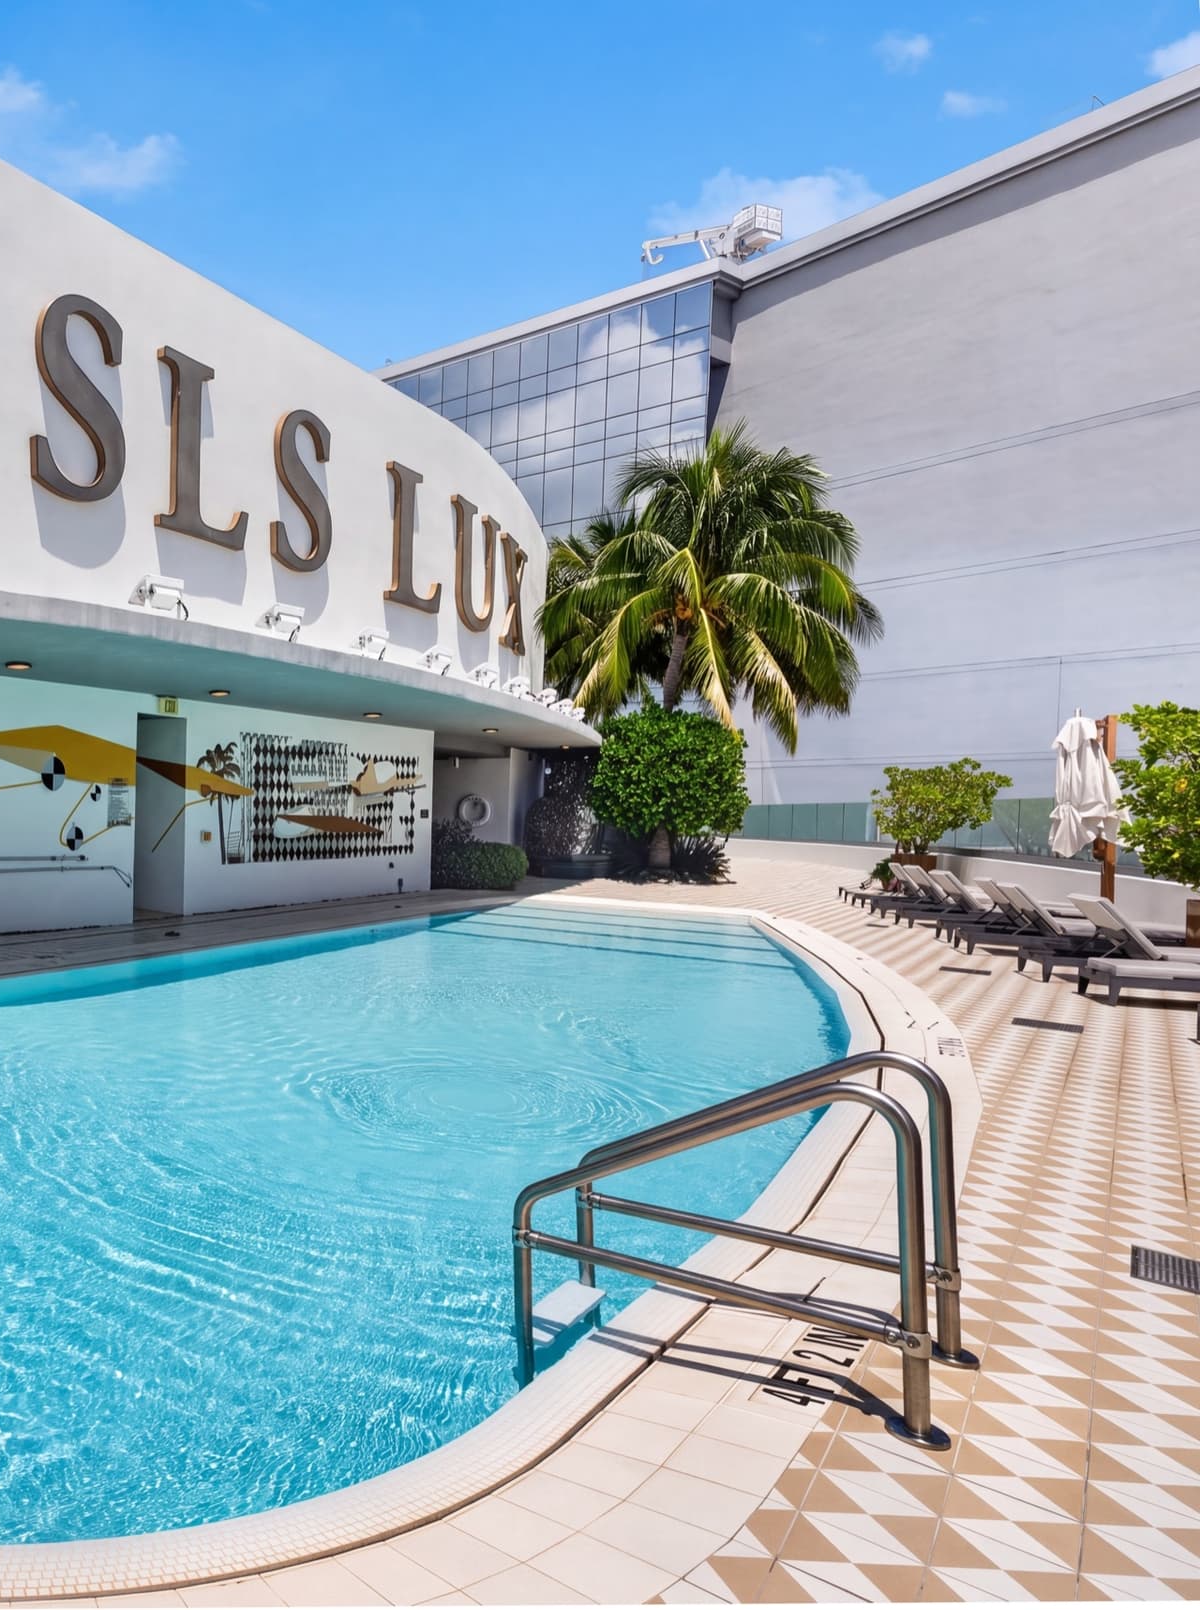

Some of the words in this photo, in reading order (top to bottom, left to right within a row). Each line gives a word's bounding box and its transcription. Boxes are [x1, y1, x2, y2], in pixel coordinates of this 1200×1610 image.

[29, 293, 332, 573] SLS
[383, 460, 529, 656] LUX
[802, 1326, 869, 1352] IN
[792, 1349, 855, 1368] 2
